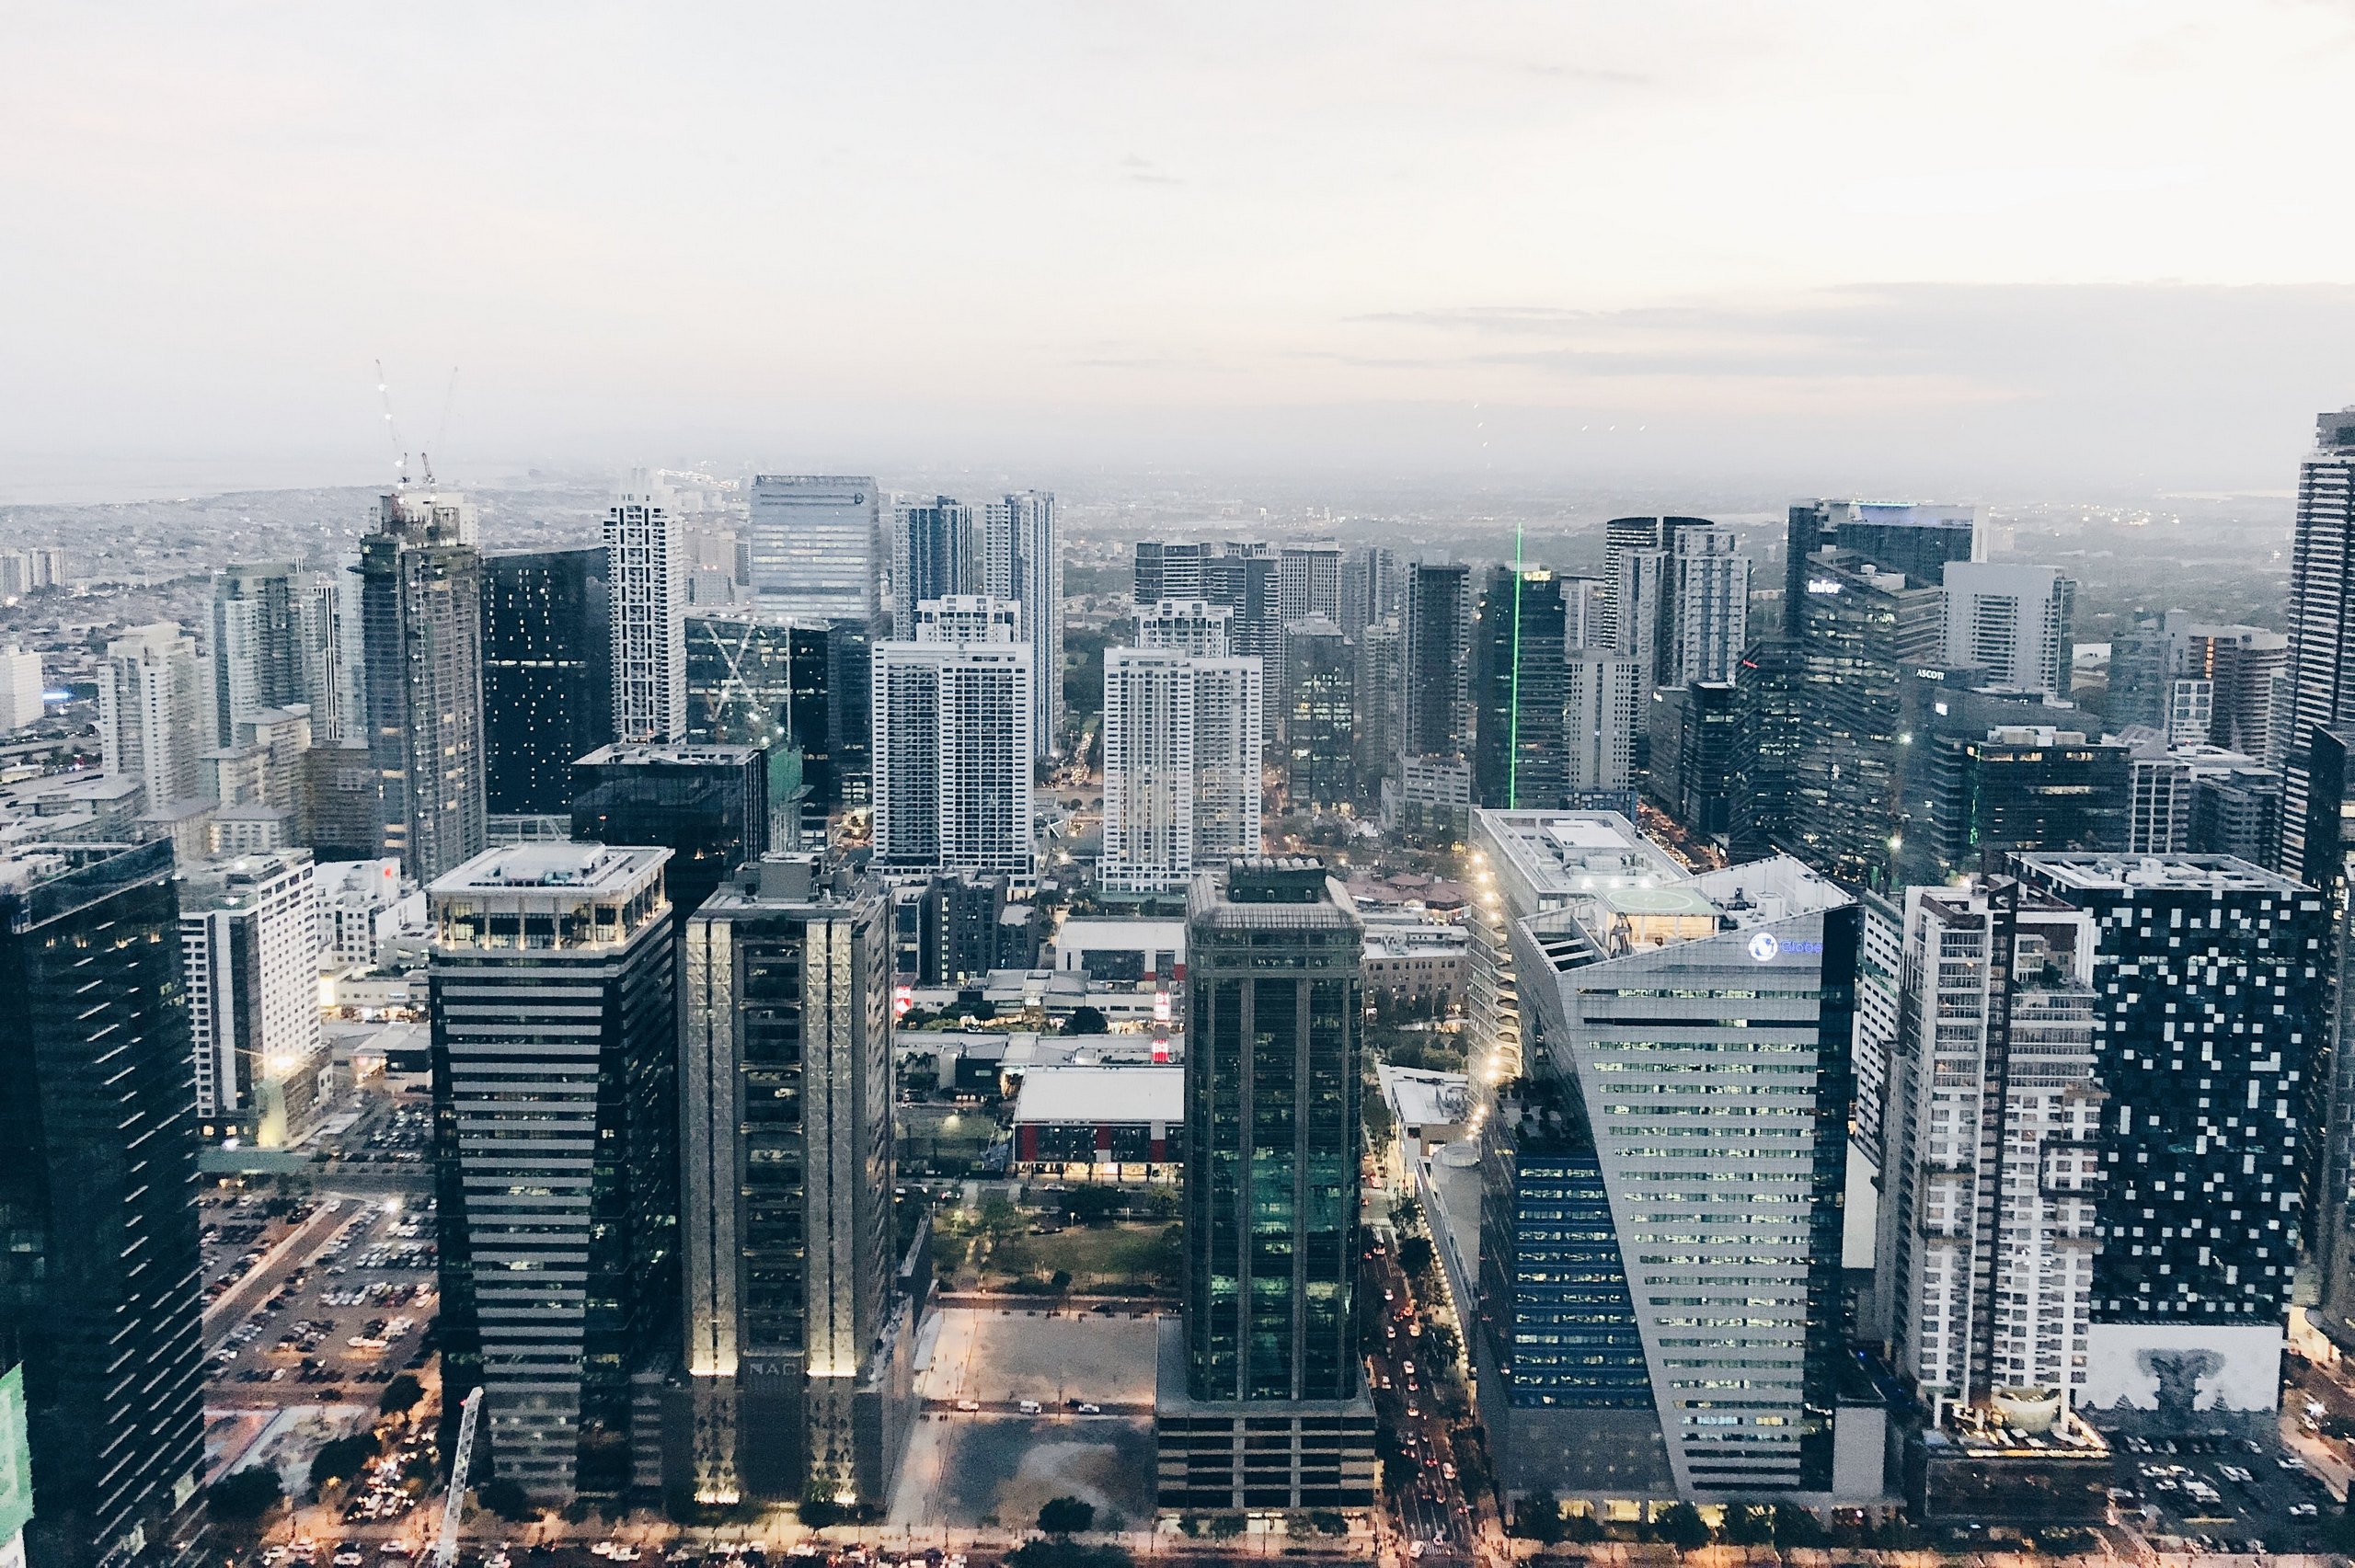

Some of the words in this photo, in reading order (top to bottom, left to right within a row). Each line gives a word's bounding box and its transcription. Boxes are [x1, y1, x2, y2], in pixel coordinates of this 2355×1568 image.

[1809, 579, 1842, 593] infor
[1916, 669, 1945, 681] ASCOTT
[1780, 940, 1822, 953] Globe
[750, 1364, 797, 1376] NAC
